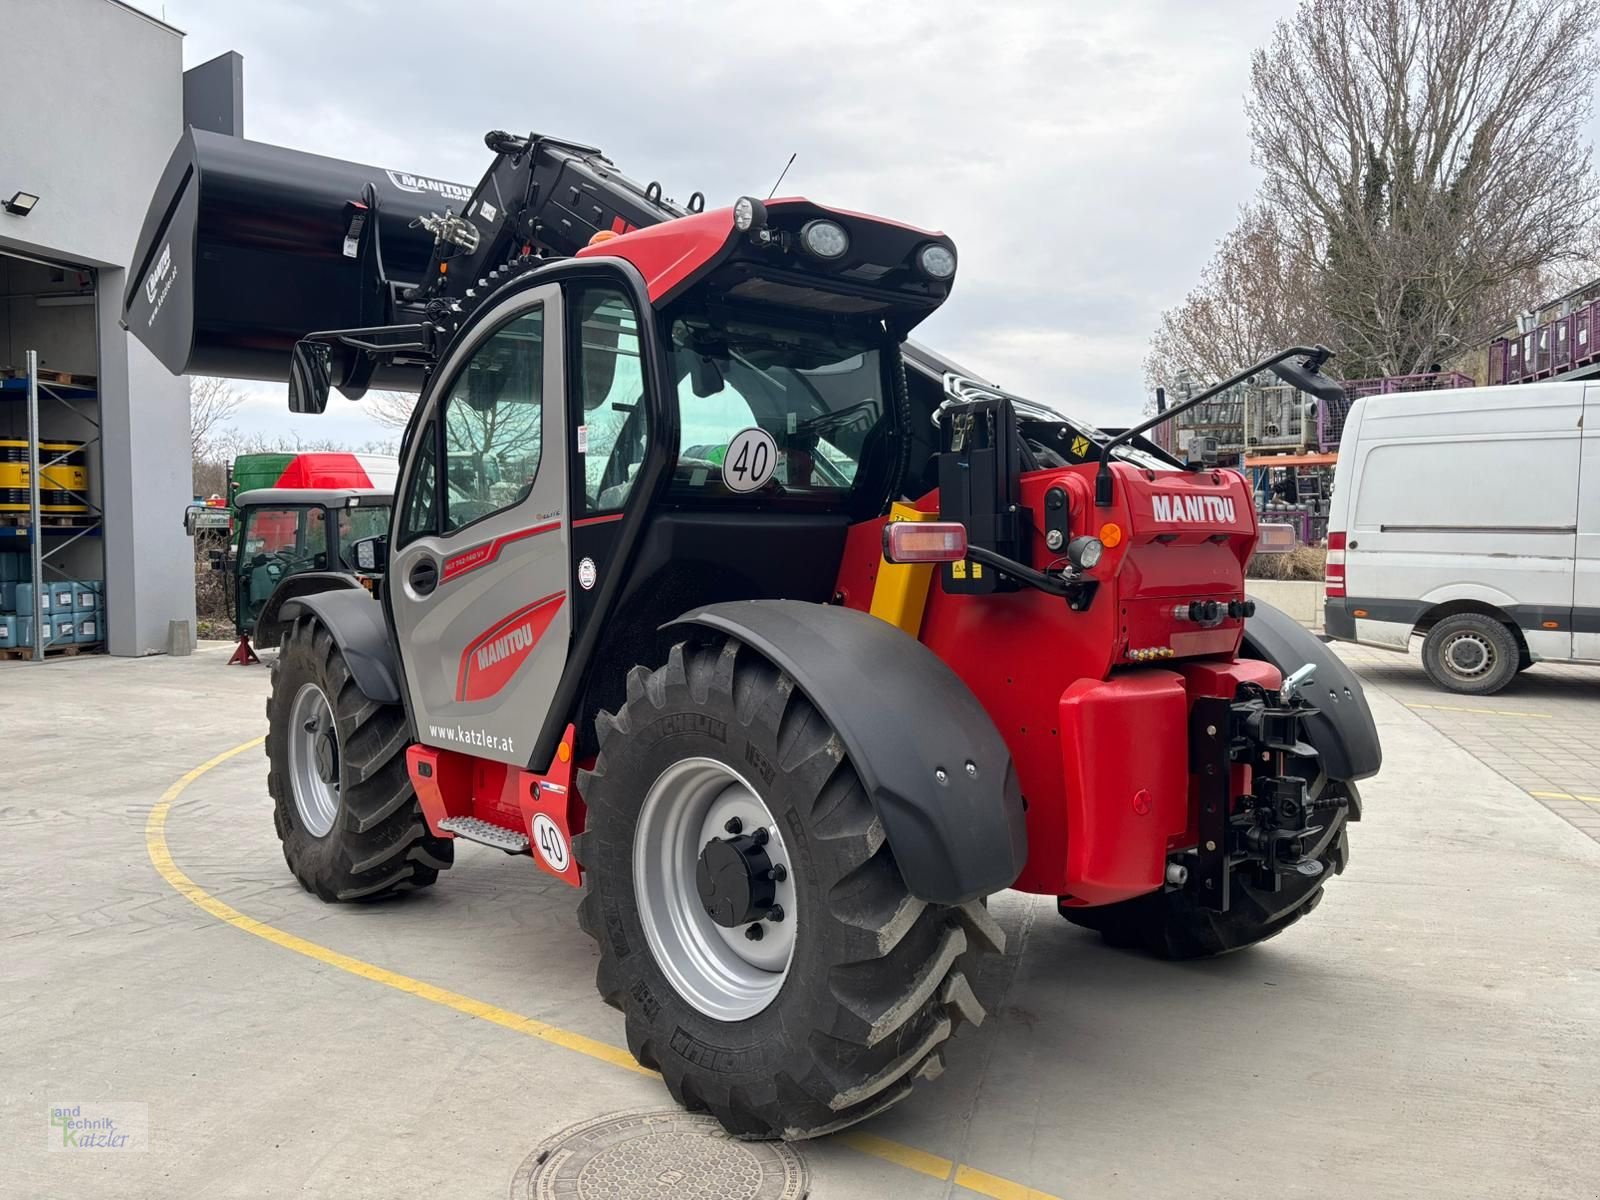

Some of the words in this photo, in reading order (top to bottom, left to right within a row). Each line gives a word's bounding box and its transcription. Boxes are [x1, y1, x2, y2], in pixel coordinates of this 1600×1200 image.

[402, 174, 473, 198] MANITOU
[732, 440, 768, 482] 40
[1152, 494, 1237, 524] MANITOU
[477, 623, 533, 671] MANITOU
[429, 725, 514, 753] www.katzler.at
[540, 824, 563, 863] 40
